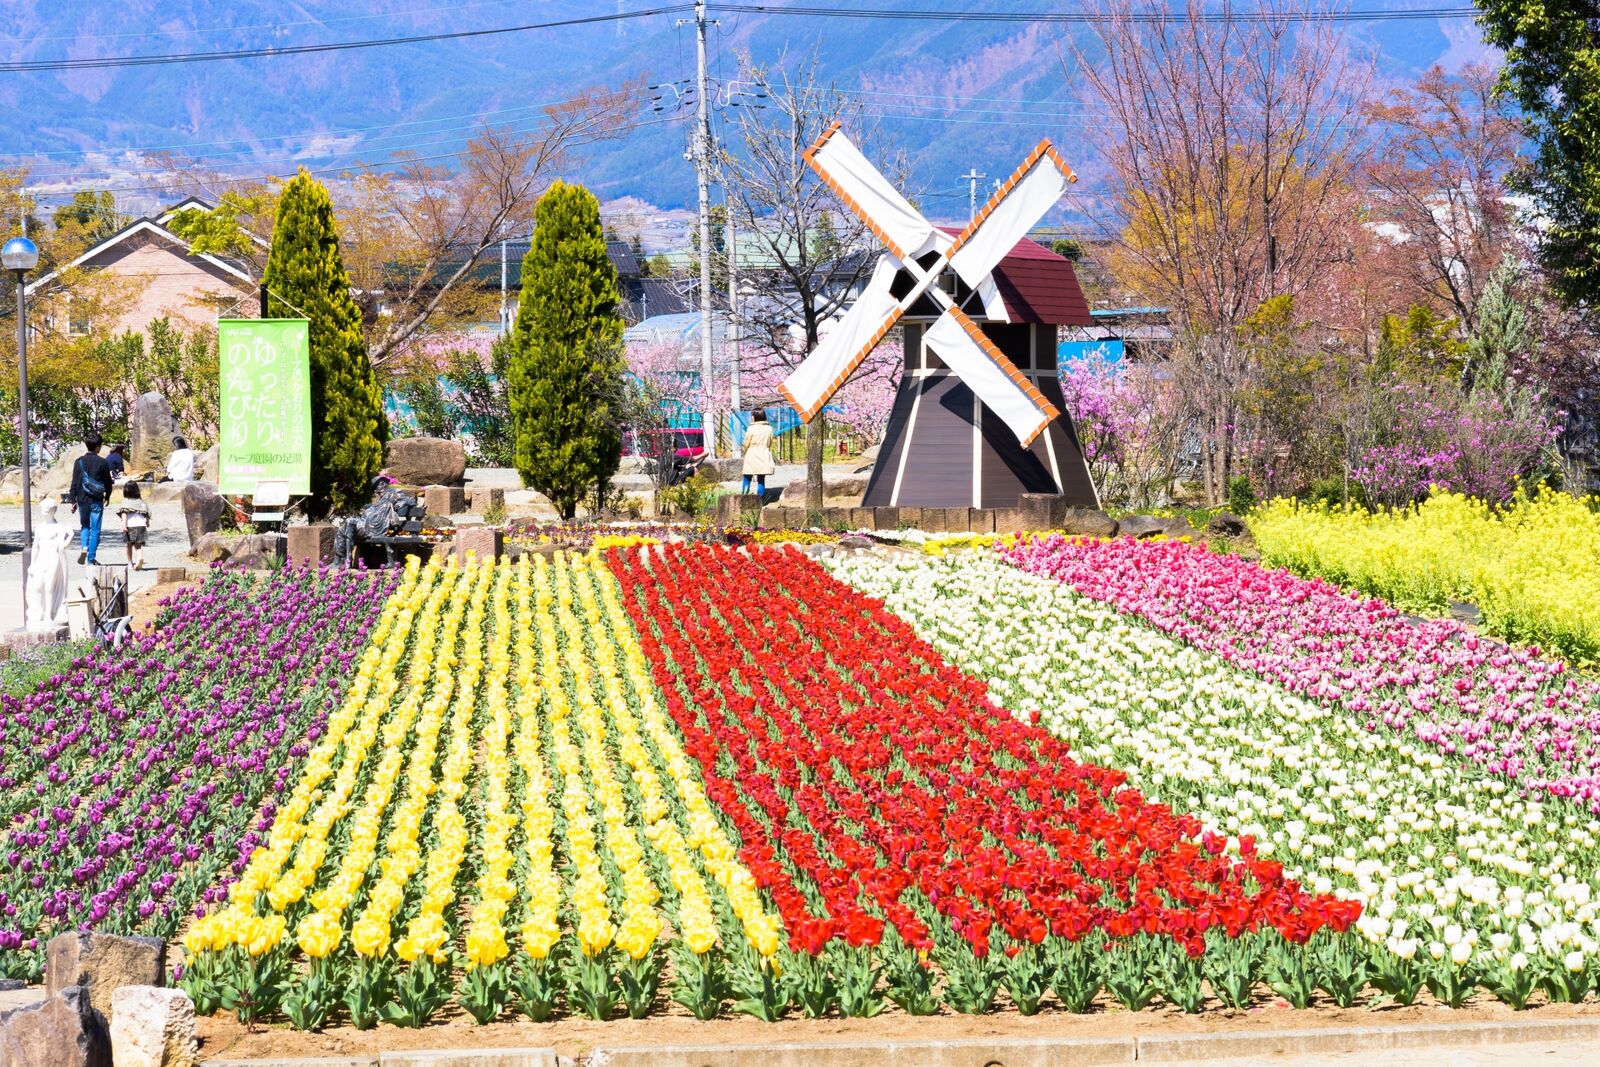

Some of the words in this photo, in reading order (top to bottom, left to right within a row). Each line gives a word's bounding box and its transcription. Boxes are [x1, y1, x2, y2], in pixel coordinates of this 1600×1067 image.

[226, 343, 254, 447] のんびり
[254, 340, 278, 446] ゆったり
